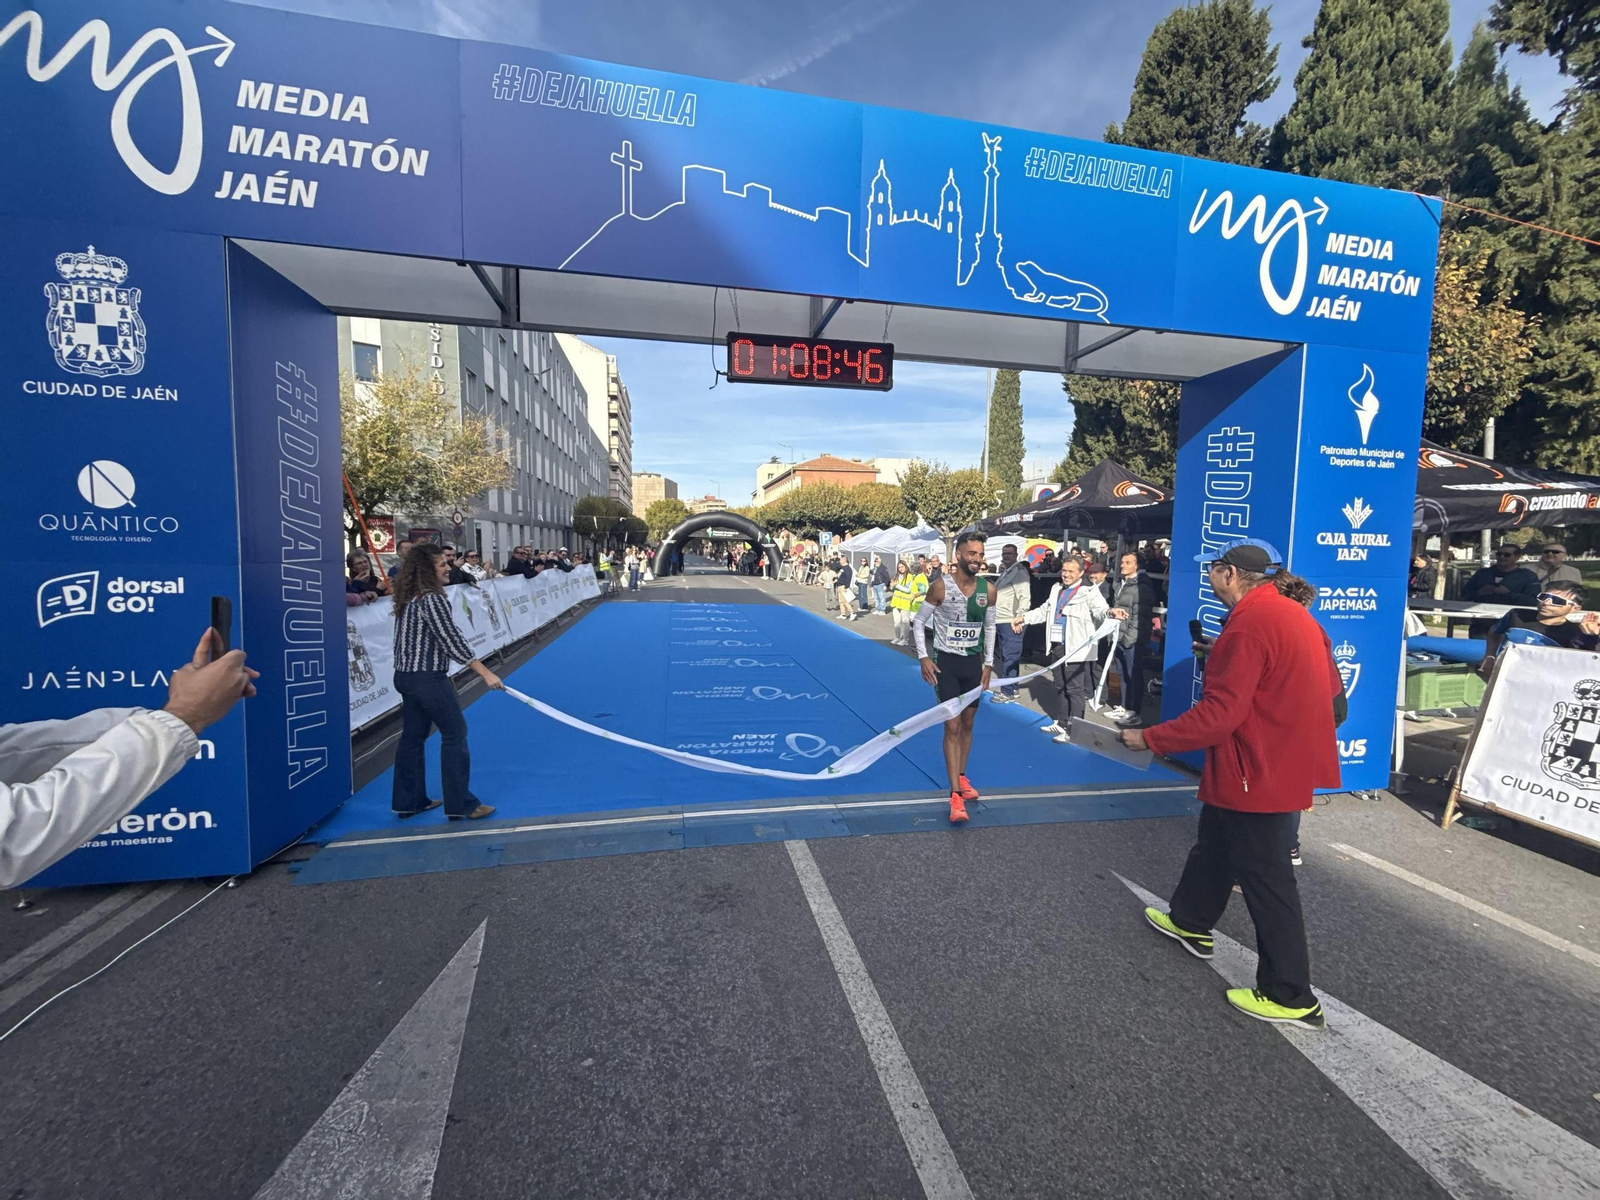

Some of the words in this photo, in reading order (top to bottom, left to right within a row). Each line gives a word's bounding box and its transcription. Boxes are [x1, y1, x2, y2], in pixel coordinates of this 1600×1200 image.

[236, 79, 369, 125] MEDIA
[492, 63, 697, 127] #DEJAHUELLA
[228, 125, 430, 177] MARATÓN
[1024, 147, 1173, 198] #DEJAHUELLA
[214, 170, 319, 208] JAÉN
[1325, 232, 1394, 261] MEDIA
[1317, 263, 1421, 297] MARATÓN
[1306, 294, 1362, 322] JAÉN
[428, 322, 446, 395] SIDAD
[22, 380, 97, 397] CIUDAD
[102, 384, 127, 399] DE
[131, 385, 179, 401] JAÉN
[1320, 445, 1358, 456] Patronato
[1359, 447, 1395, 459] Municipal
[1395, 450, 1405, 459] de
[1330, 456, 1365, 467] Deportes
[1366, 458, 1376, 467] de
[1377, 459, 1395, 469] Jaén
[1529, 491, 1600, 511] cruzandola
[125, 535, 152, 543] DISEÑO
[1316, 532, 1347, 546] CAJA
[1350, 533, 1391, 546] RURAL
[1336, 546, 1368, 561] JAÉN
[107, 576, 184, 594] dorsal
[275, 361, 328, 790] #DEJAHUELLA
[1319, 586, 1378, 597] DACIA
[107, 595, 155, 613] GO!
[1318, 598, 1377, 611] JAPEMASA
[954, 628, 976, 638] 690
[22, 665, 177, 690] JAÉNPLA
[368, 692, 377, 702] DE
[708, 747, 774, 755] MEDIA
[1336, 738, 1368, 758] US
[1500, 774, 1570, 803] CIUDAD
[1573, 796, 1600, 814] DE
[111, 835, 173, 847] maestras
